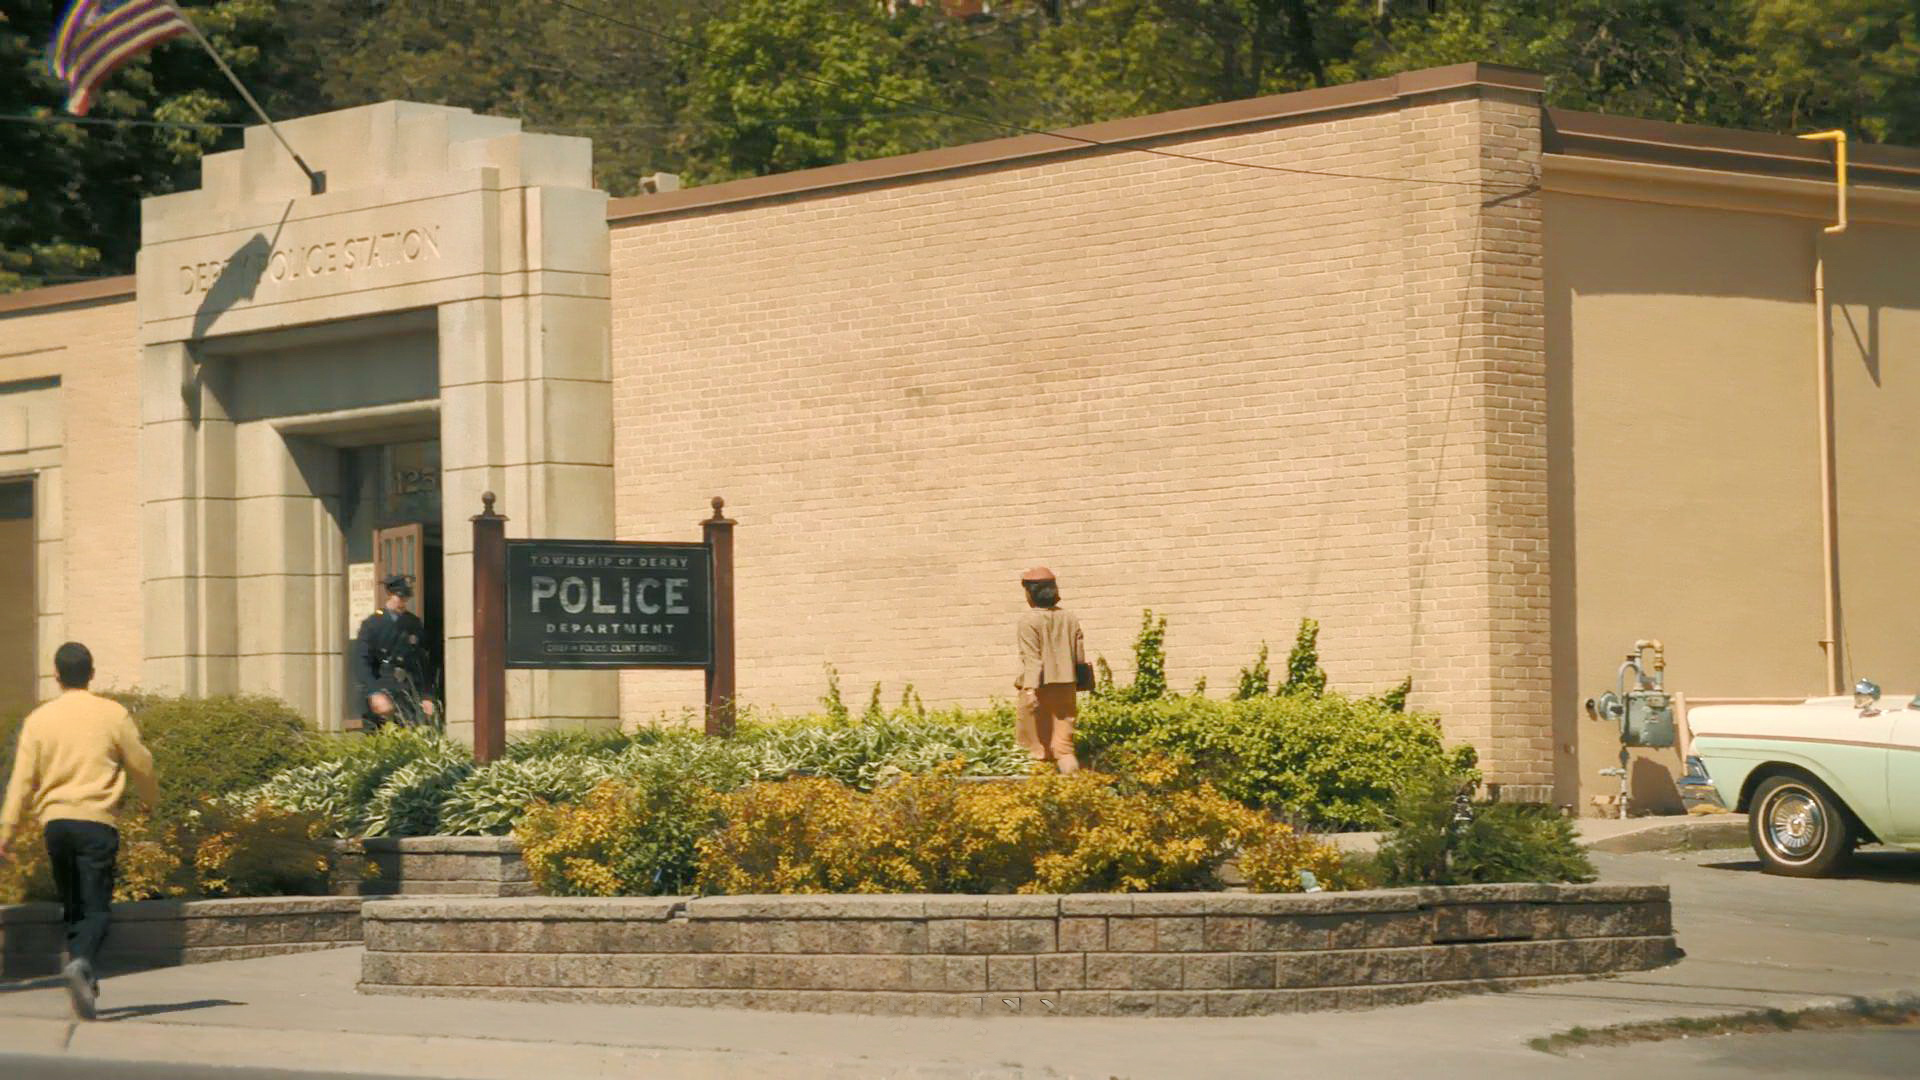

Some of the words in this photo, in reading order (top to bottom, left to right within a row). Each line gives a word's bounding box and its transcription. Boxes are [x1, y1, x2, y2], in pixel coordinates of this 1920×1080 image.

[179, 253, 251, 296] DERY
[343, 225, 441, 270] STATION
[530, 555, 613, 567] TOWNSHIP
[639, 557, 688, 568] DERRY
[530, 575, 690, 615] POLICE
[546, 623, 675, 635] DEPARTMENT
